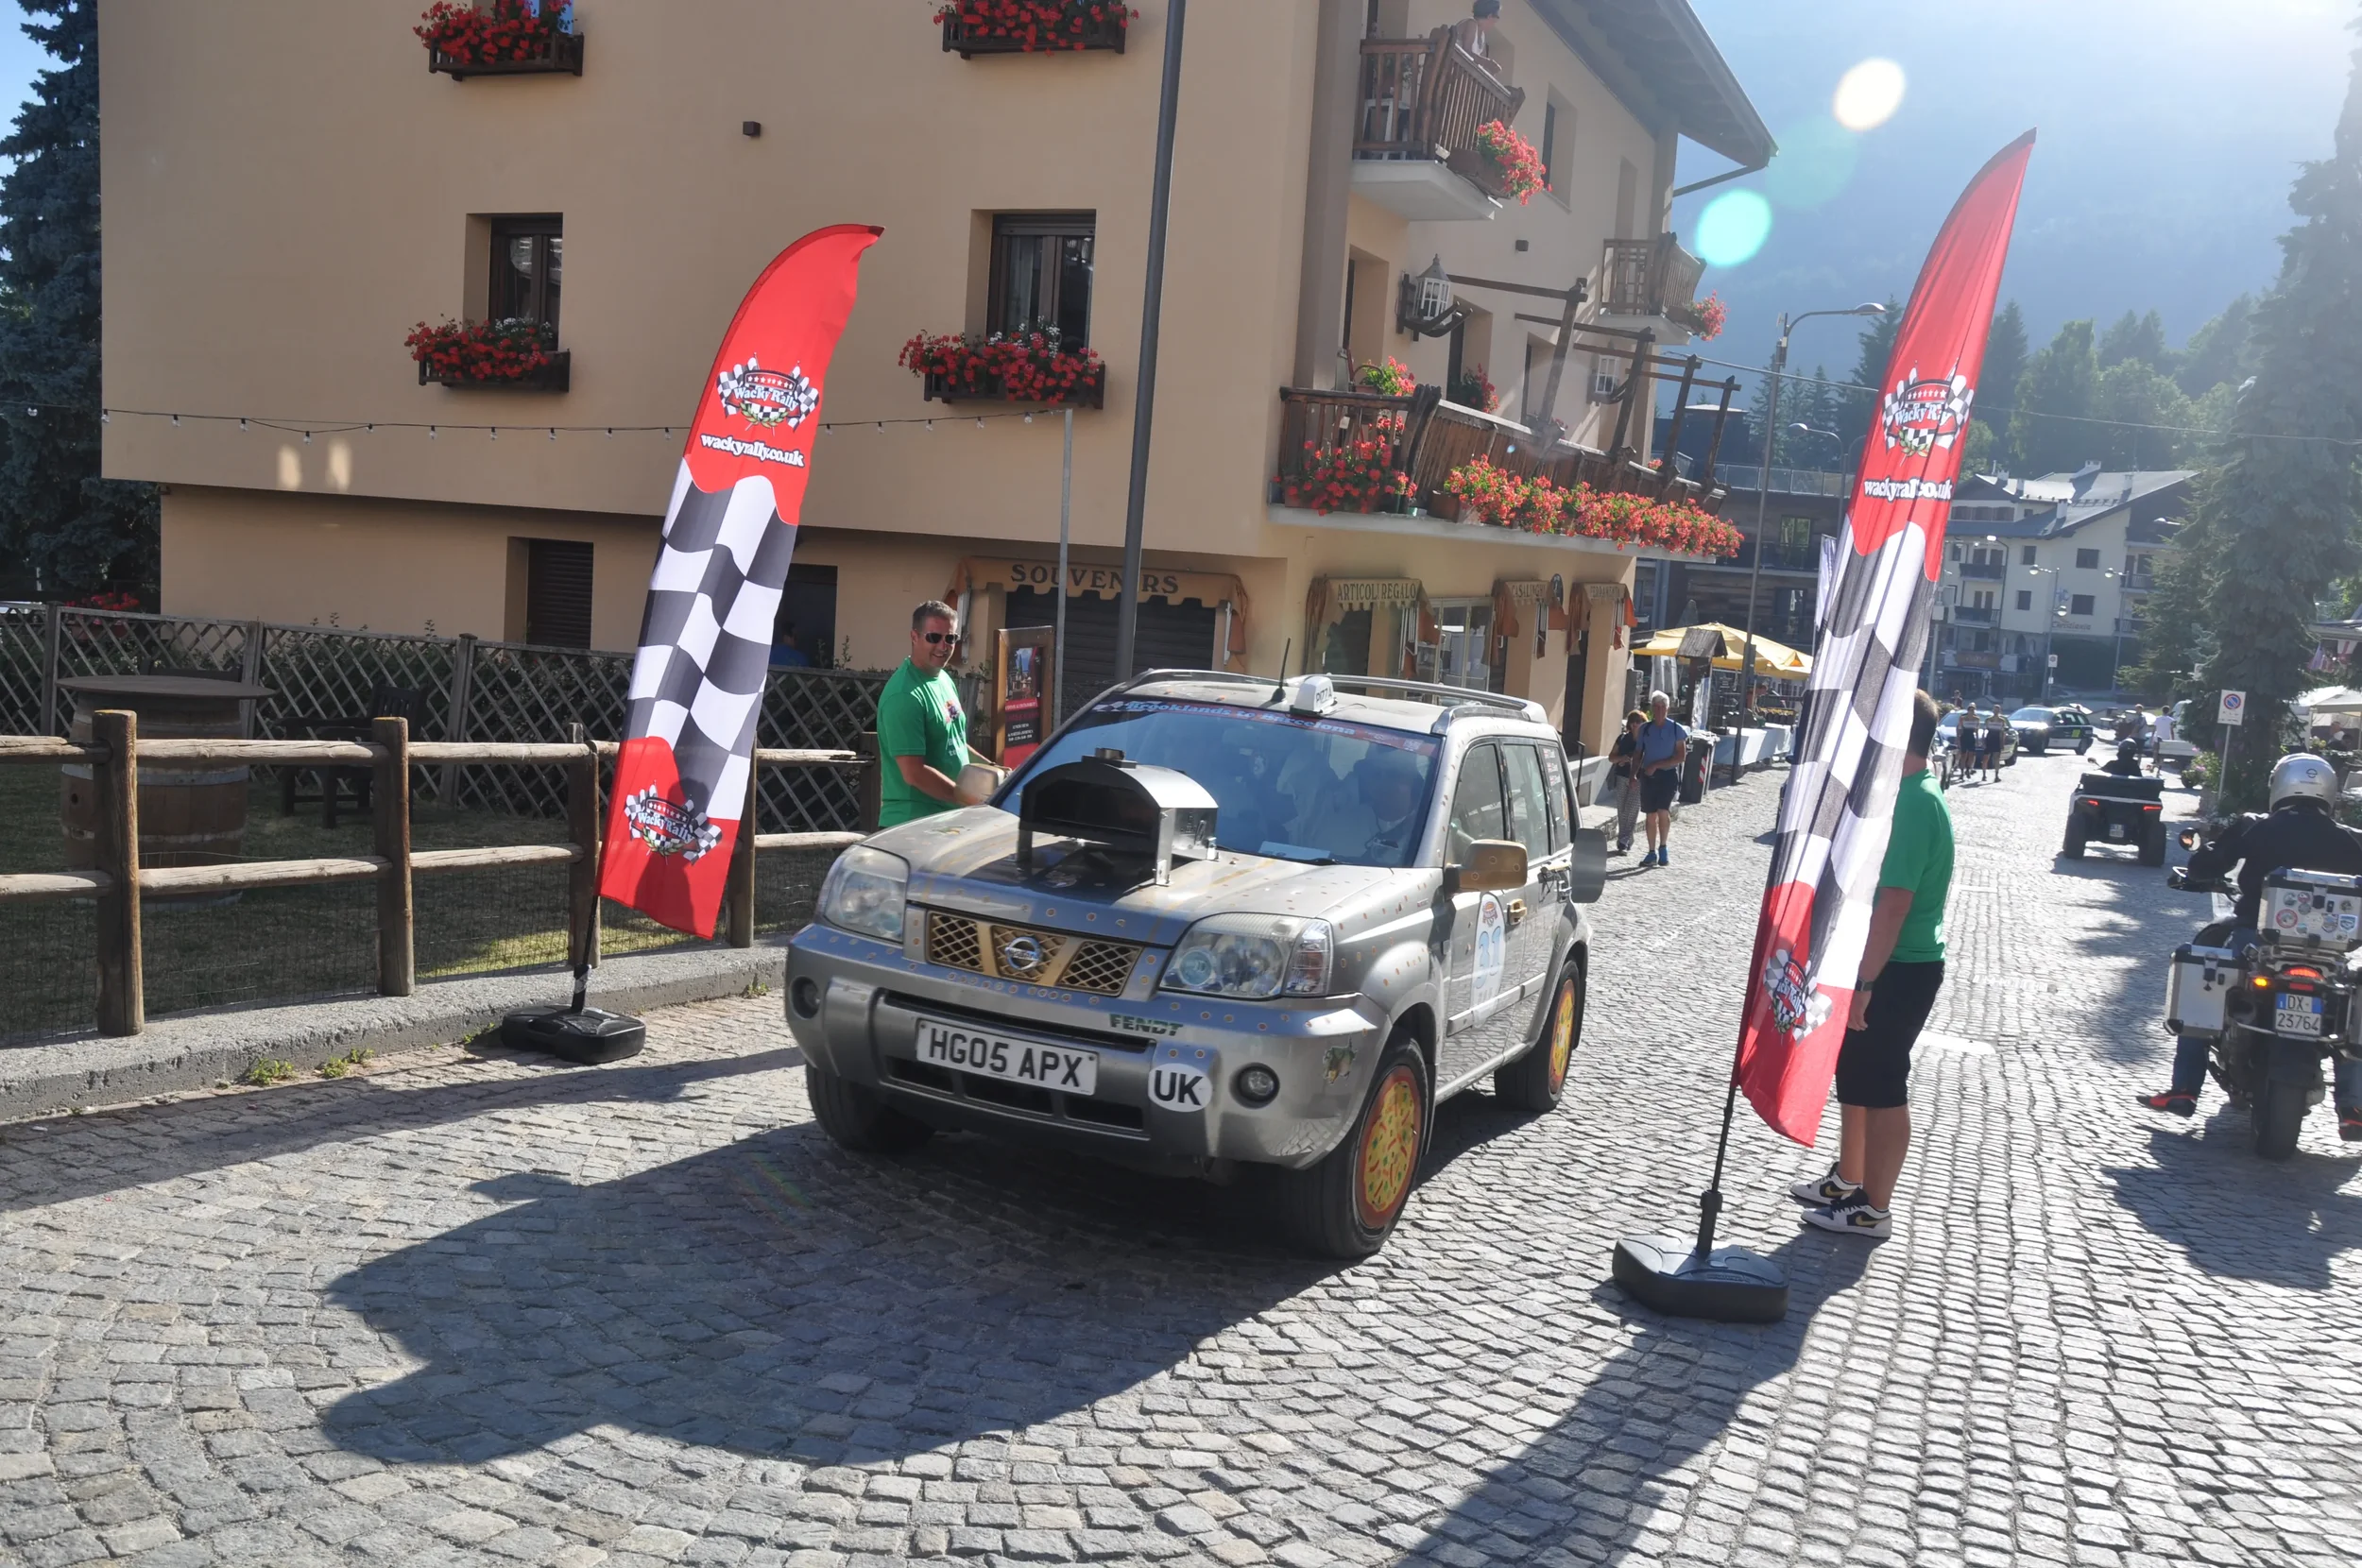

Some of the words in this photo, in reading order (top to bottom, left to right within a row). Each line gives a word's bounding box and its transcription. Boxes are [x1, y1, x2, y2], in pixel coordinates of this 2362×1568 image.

[734, 385, 770, 401] Wacky
[770, 389, 798, 411] Rally
[1894, 404, 1926, 426] Wacky
[700, 434, 805, 468] wackyrally.co.uk
[1011, 564, 1179, 594] SOUVENRS
[1338, 583, 1379, 601] ARTICOLI
[1381, 583, 1416, 600] REGALO
[1125, 700, 1232, 716] Brooklands
[1236, 708, 1256, 718] to
[1261, 712, 1356, 735] Barcelona
[638, 811, 667, 829] Wacky
[666, 817, 694, 844] Rally
[1473, 926, 1501, 990] 31
[2287, 995, 2304, 1012] DX
[1109, 1013, 1184, 1036] FENDT
[2277, 1013, 2320, 1031] 23764
[929, 1028, 1010, 1073] HG05
[1017, 1048, 1083, 1087] APX
[1154, 1069, 1203, 1106] UK
